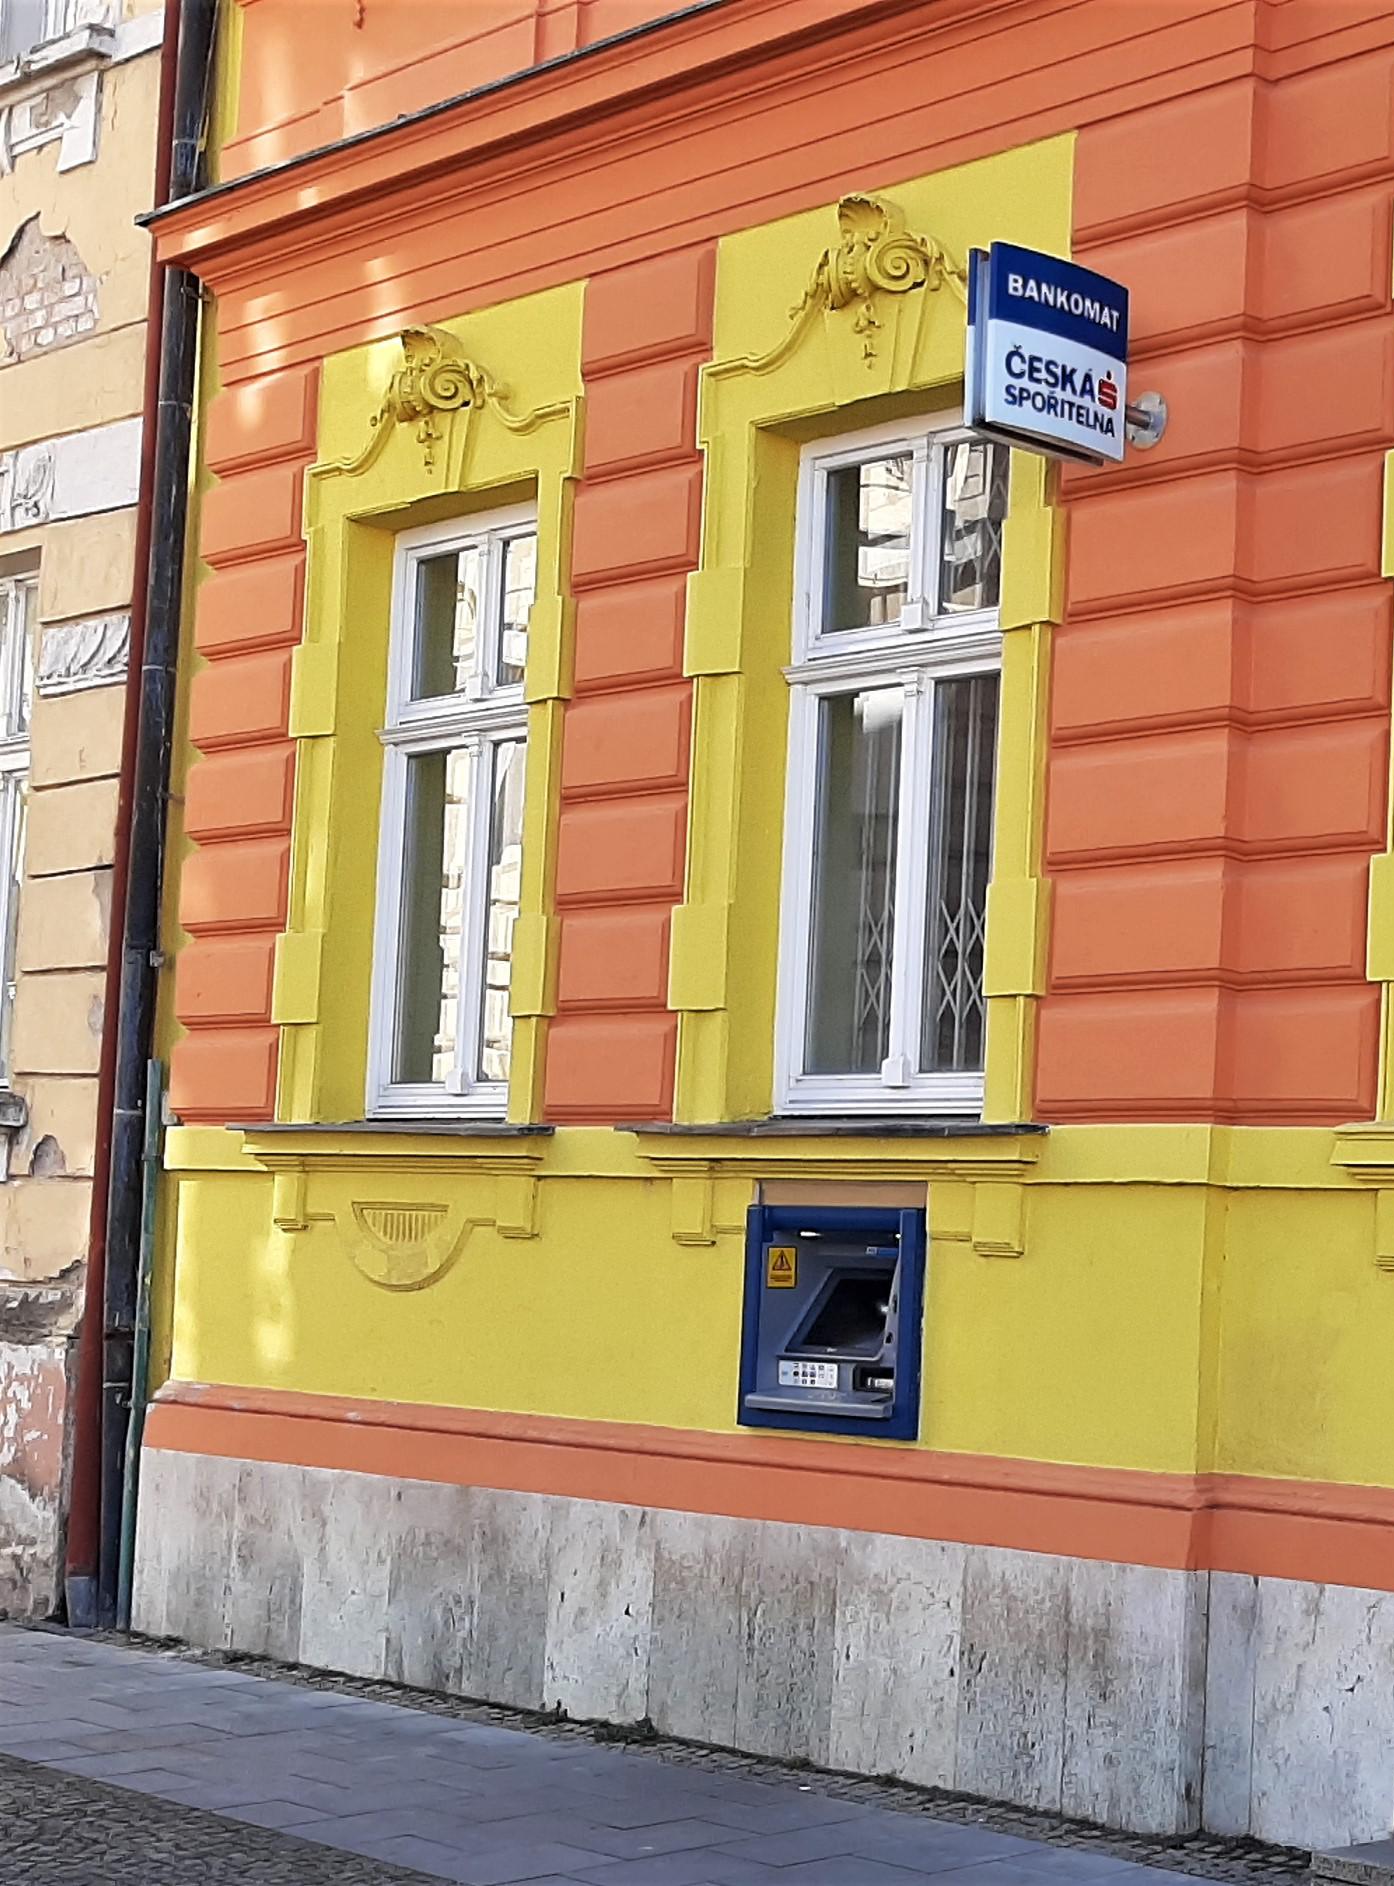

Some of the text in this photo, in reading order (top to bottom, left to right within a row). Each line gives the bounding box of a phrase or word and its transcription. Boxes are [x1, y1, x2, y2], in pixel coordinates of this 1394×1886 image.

[1007, 273, 1120, 333] BANKOMAT
[1005, 344, 1098, 404] ČESKÁ
[1004, 384, 1115, 438] SPOŘITELNA
